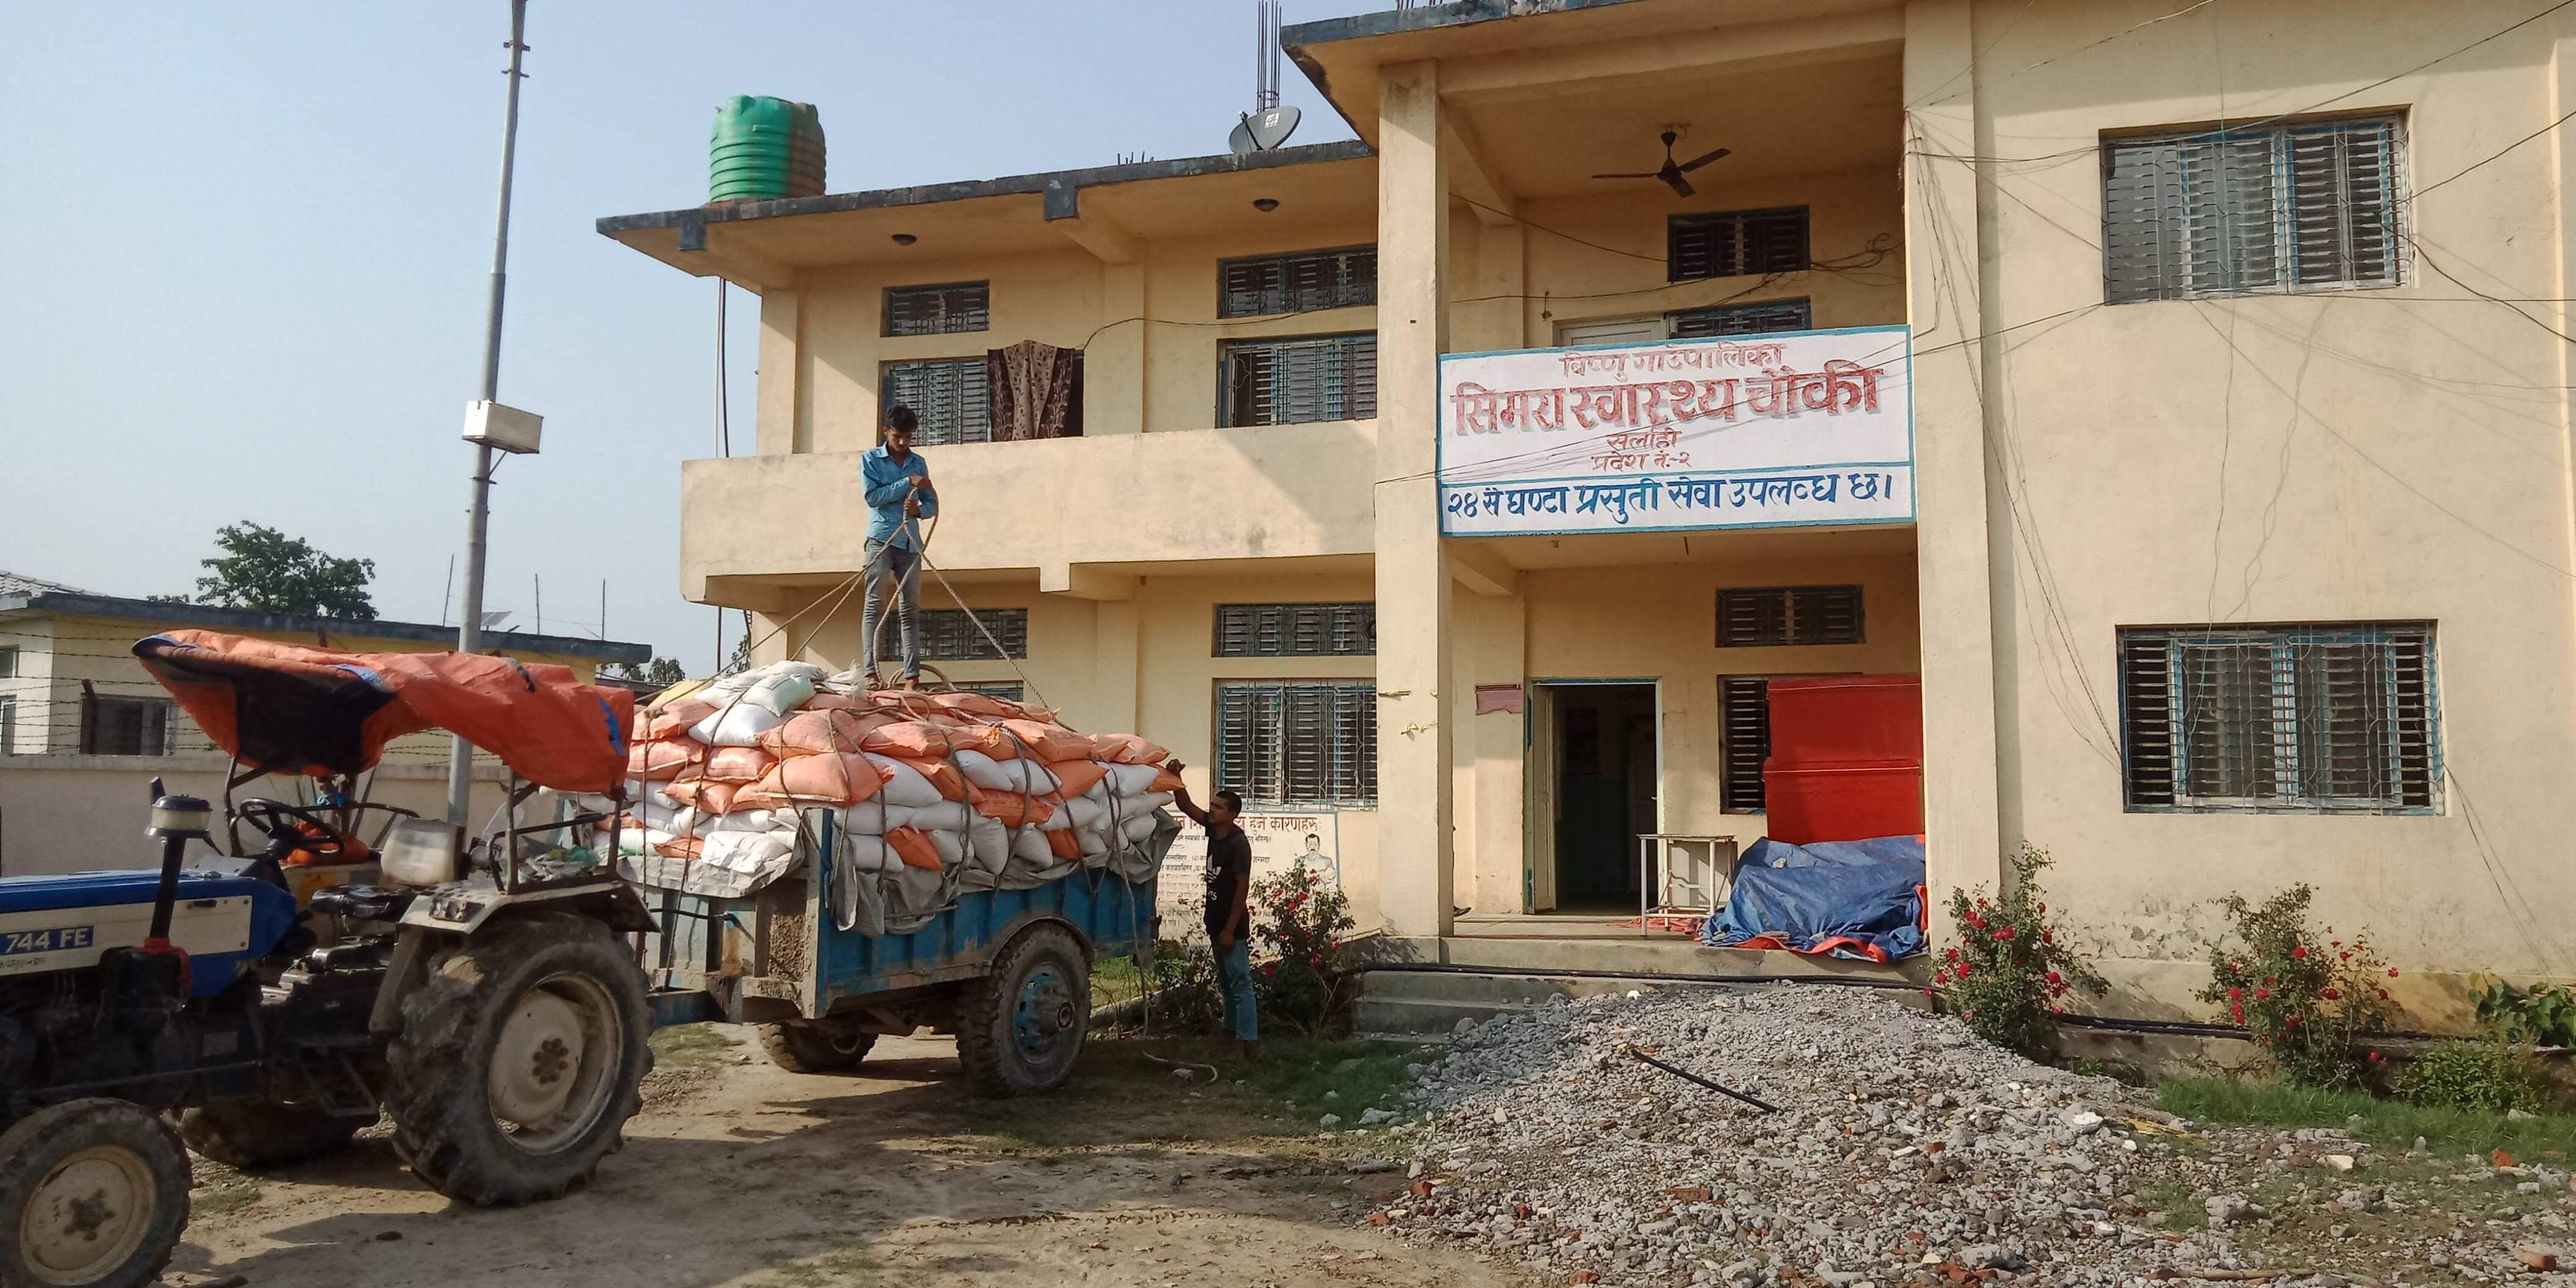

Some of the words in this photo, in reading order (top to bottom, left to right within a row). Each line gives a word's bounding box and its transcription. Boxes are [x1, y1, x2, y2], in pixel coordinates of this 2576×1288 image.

[1450, 381, 1566, 435] सिमरा
[1745, 359, 1884, 417] चौकी
[1591, 450, 1650, 472] प्रदेश
[1448, 492, 1479, 518] २४
[1505, 486, 1570, 516] घण्टा
[1574, 478, 1664, 525] प्रसुती
[1666, 476, 1728, 509] सेवा
[5, 931, 50, 954] 744
[60, 928, 89, 948] FE
